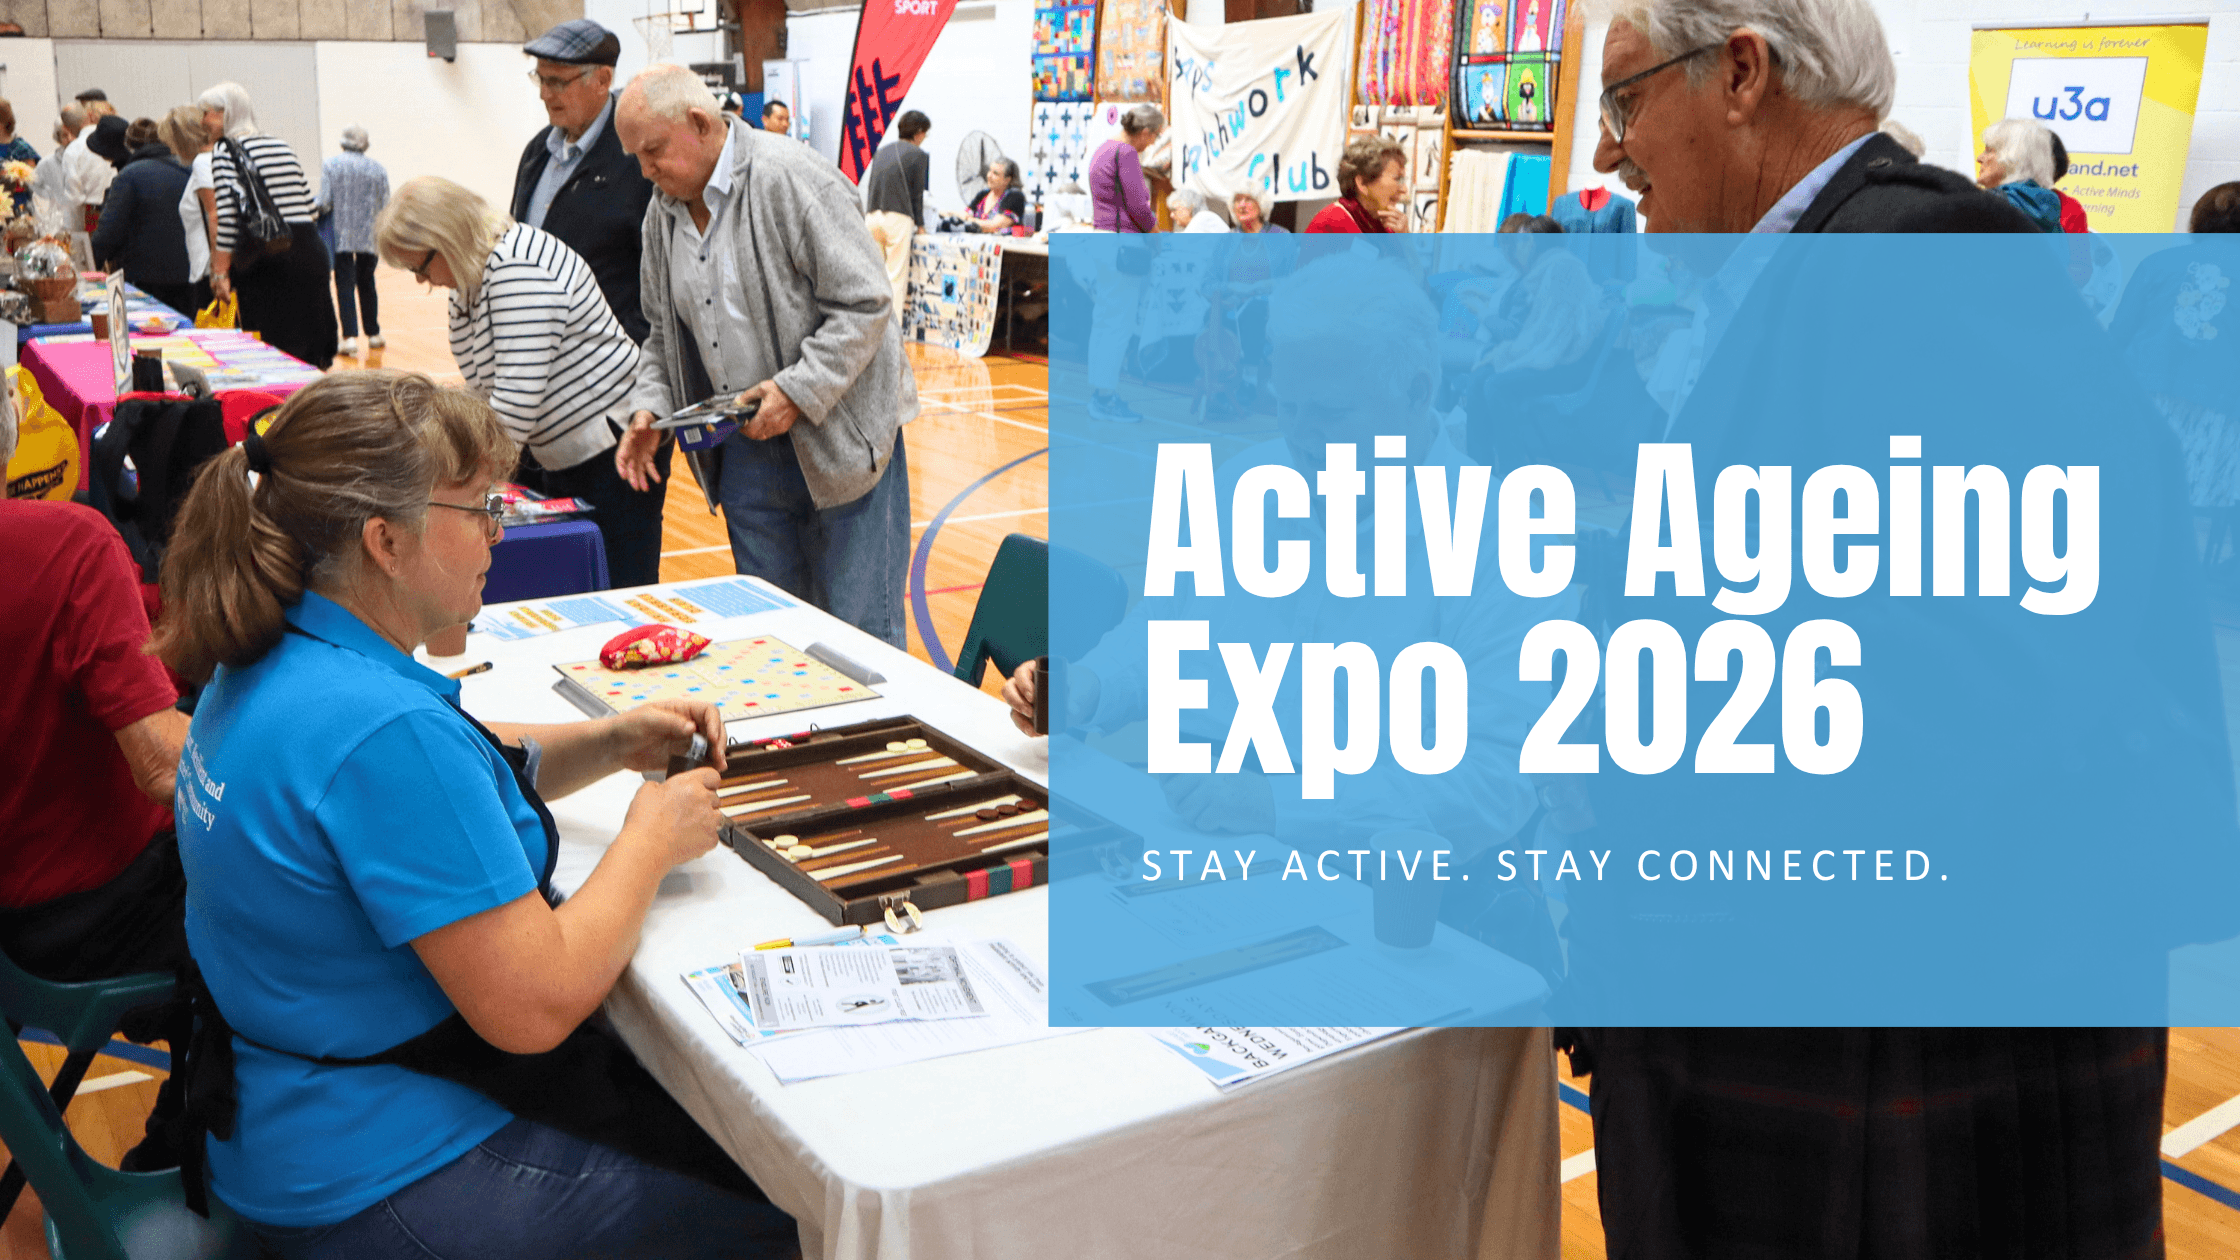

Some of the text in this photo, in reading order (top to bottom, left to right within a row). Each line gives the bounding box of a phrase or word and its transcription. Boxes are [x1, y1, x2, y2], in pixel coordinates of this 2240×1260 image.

[894, 0, 938, 15] SPORT
[2014, 36, 2150, 52] Learning is forever
[2032, 86, 2111, 121] u3a
[1248, 151, 1330, 195] Club
[2068, 160, 2139, 177] and.net
[2072, 185, 2141, 199] Active Minds
[204, 778, 225, 802] and
